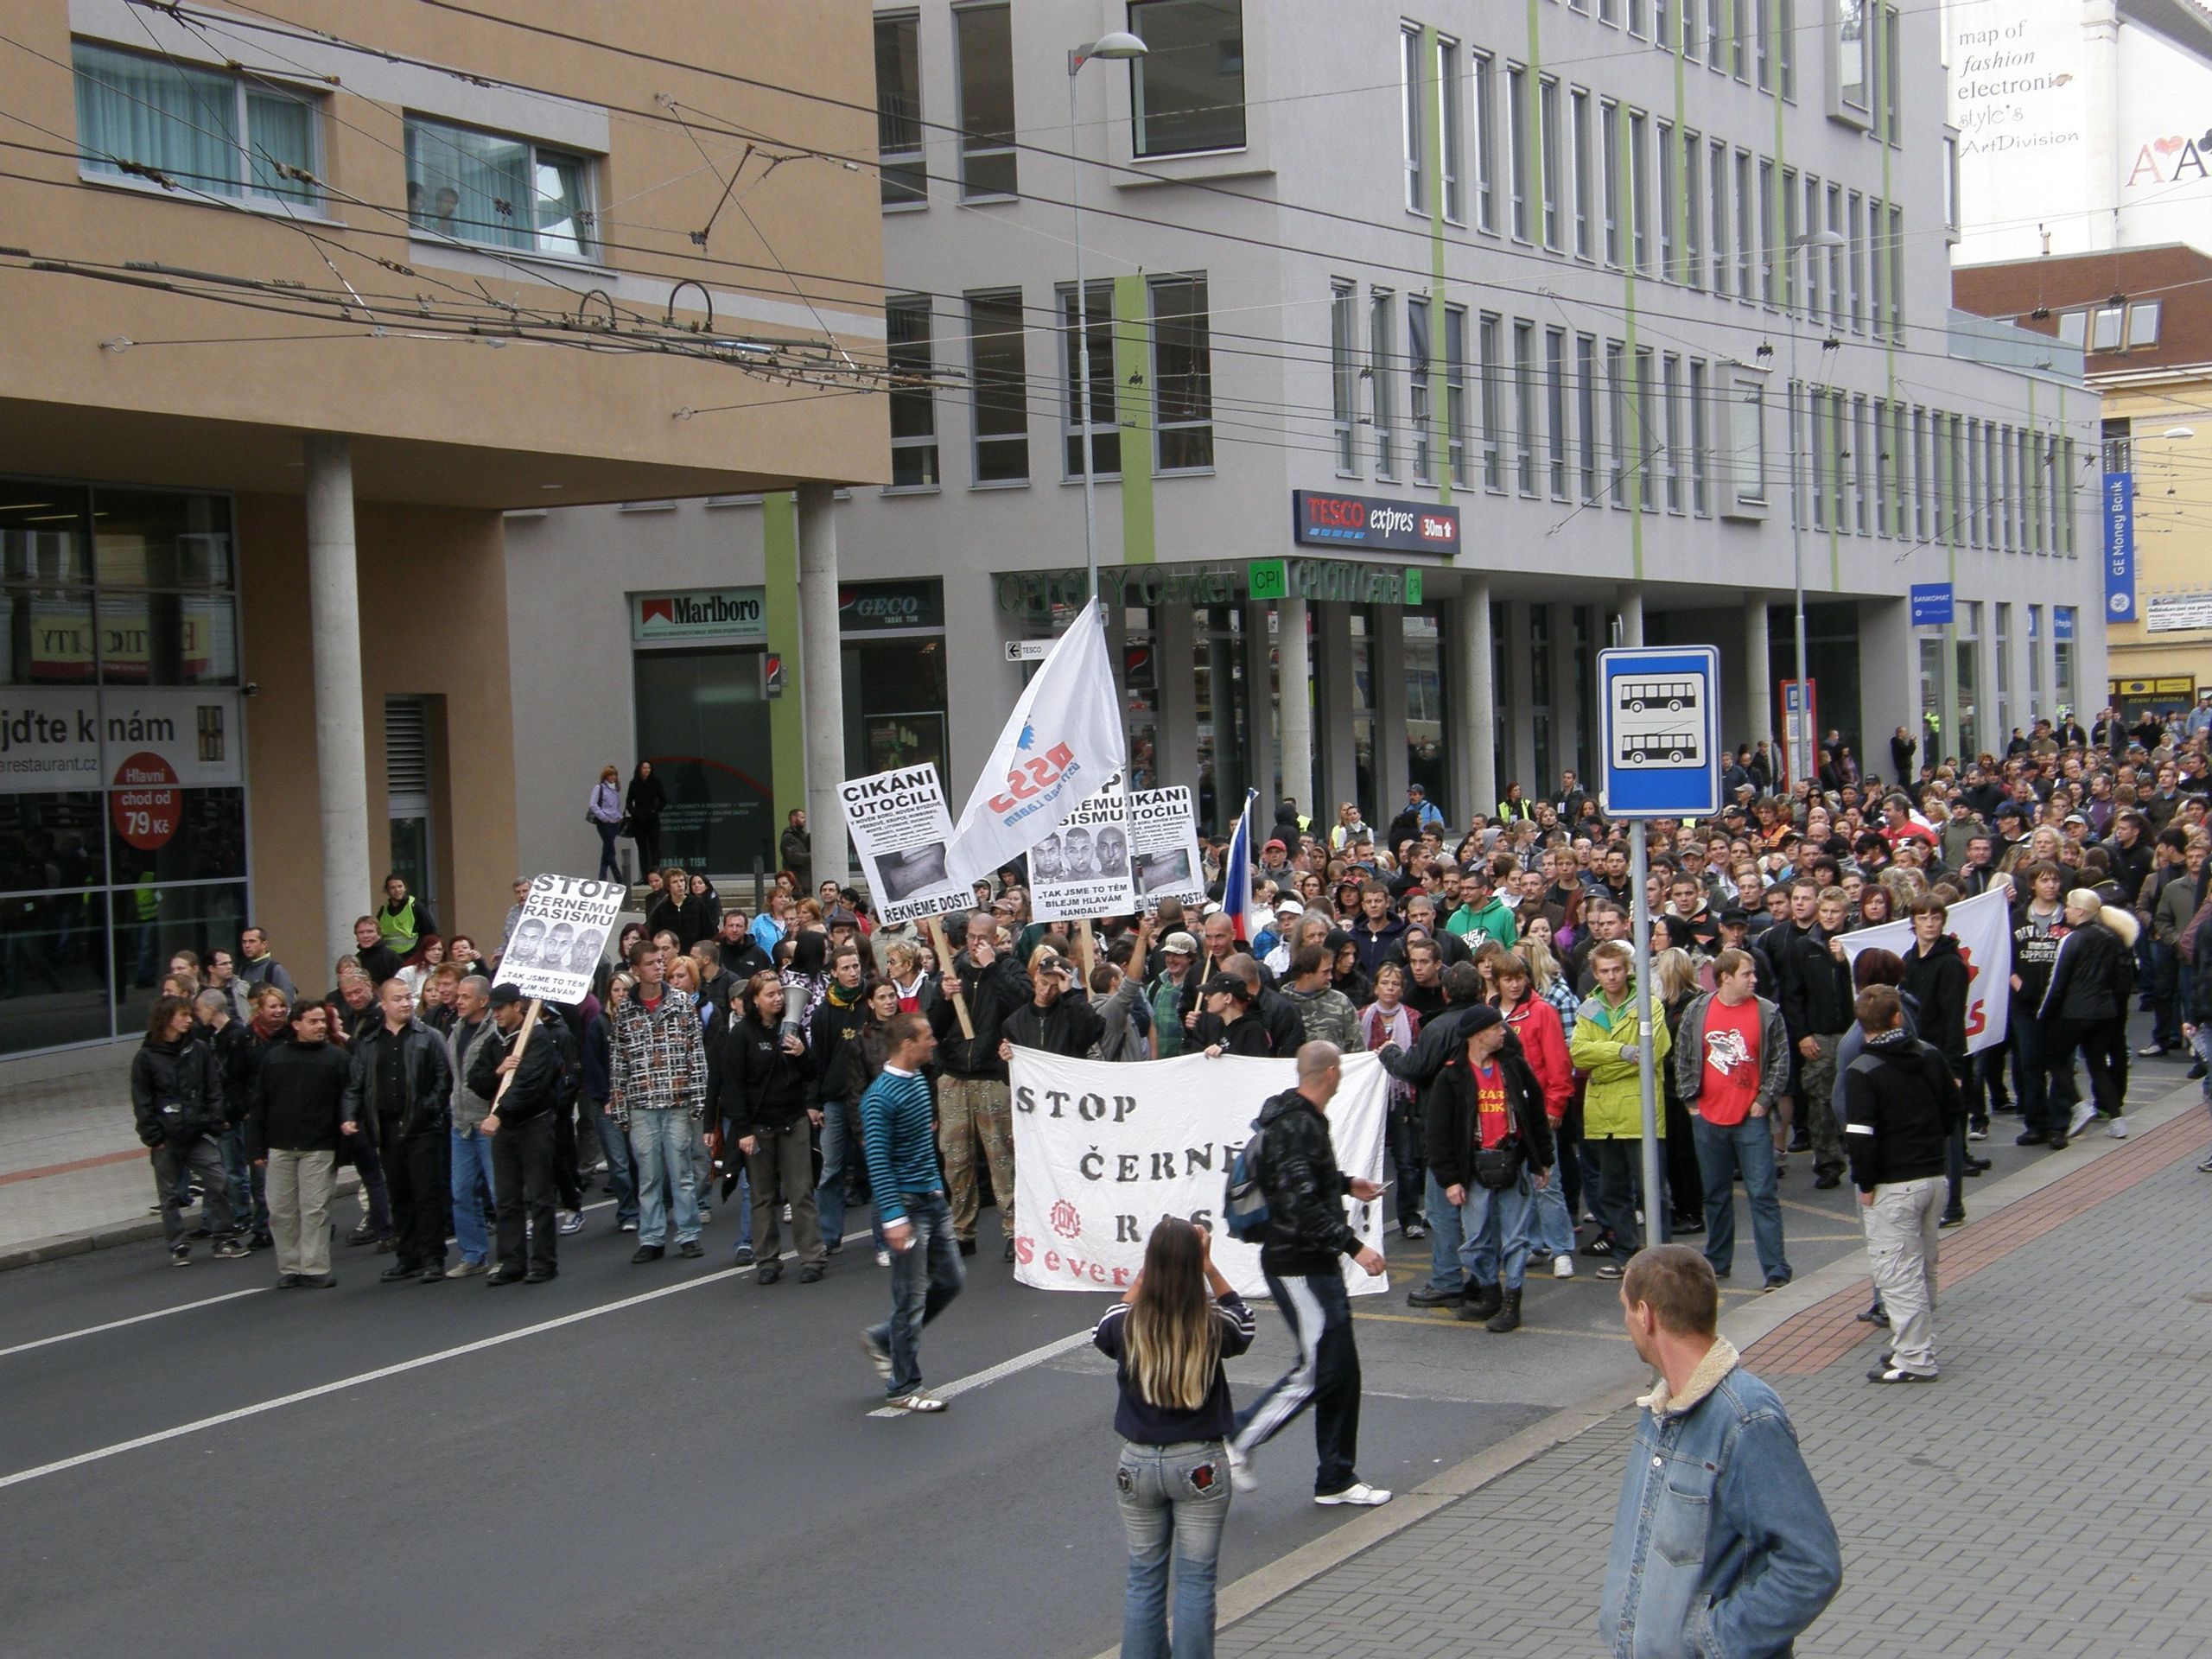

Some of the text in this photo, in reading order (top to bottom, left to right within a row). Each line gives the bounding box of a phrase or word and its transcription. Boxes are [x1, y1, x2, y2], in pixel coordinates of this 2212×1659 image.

[1959, 20, 2028, 46] map of
[1959, 50, 2036, 79] fashion
[1959, 131, 2080, 159] ArtDivision
[1307, 497, 1444, 538] TESCO expres 30m
[2112, 480, 2126, 576] GE Money Bank
[1139, 565, 1239, 607] Center
[1255, 570, 1280, 589] CPI
[673, 594, 760, 625] Marlboro
[856, 596, 918, 617] GECO
[78, 709, 96, 742] k
[108, 709, 175, 742] nám
[125, 767, 166, 784] Hlavní
[842, 769, 935, 803] CIKÁNI
[122, 791, 172, 806] chod od
[849, 788, 938, 818] ÚTOČILI
[1129, 786, 1188, 807] IKÁNI
[125, 812, 169, 836] 79 Kč
[1059, 809, 1123, 826] SISMU
[1128, 803, 1189, 821] TOČILI
[533, 873, 627, 900] STOP
[1064, 887, 1090, 897] JSME
[1107, 883, 1128, 893] TĚM
[523, 905, 614, 926] RASISMU
[528, 892, 618, 915] ČERNÉMU
[883, 891, 973, 923] ŘEKNĚME DOST!
[526, 974, 551, 983] JSME
[567, 979, 586, 988] TĚM
[1015, 1085, 1137, 1123] STOP
[1080, 1141, 1246, 1183] ČERNÉ
[1014, 1236, 1133, 1287] Sever
